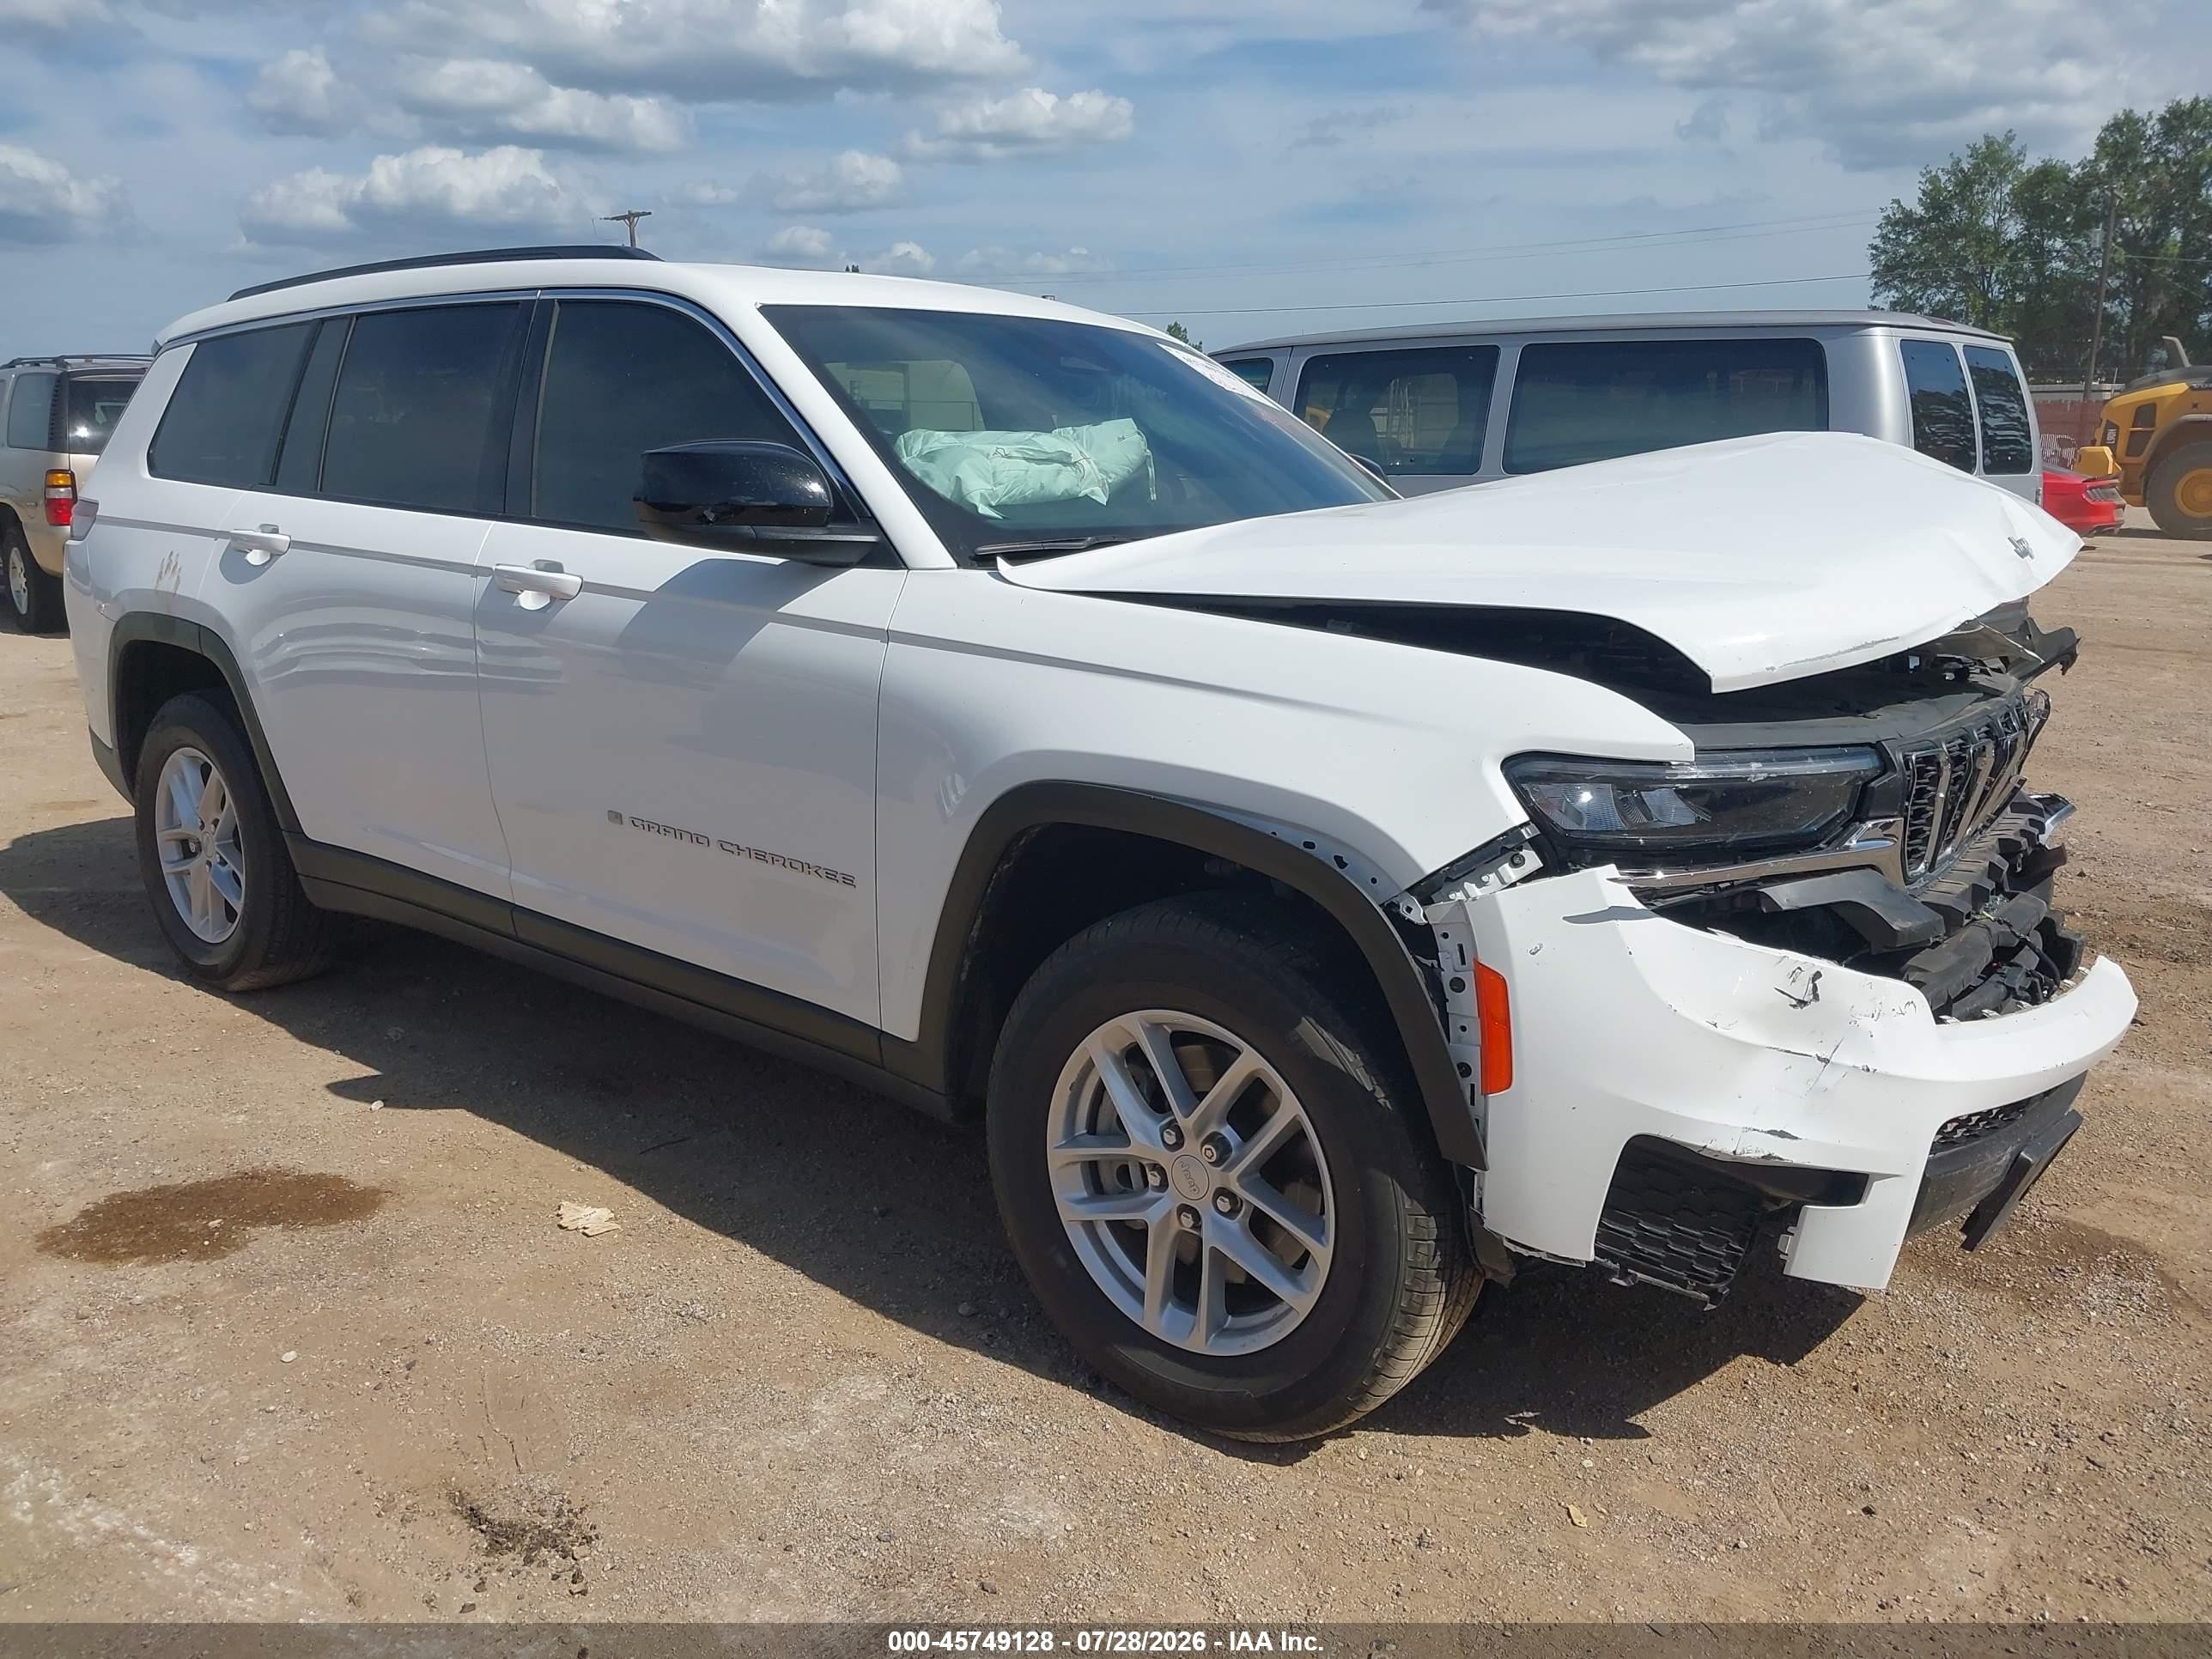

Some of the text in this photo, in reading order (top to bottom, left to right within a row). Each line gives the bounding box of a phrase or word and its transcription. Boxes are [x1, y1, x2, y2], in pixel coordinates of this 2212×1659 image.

[629, 816, 857, 889] GRAND CHEROKEE
[1179, 1160, 1200, 1194] Jeep
